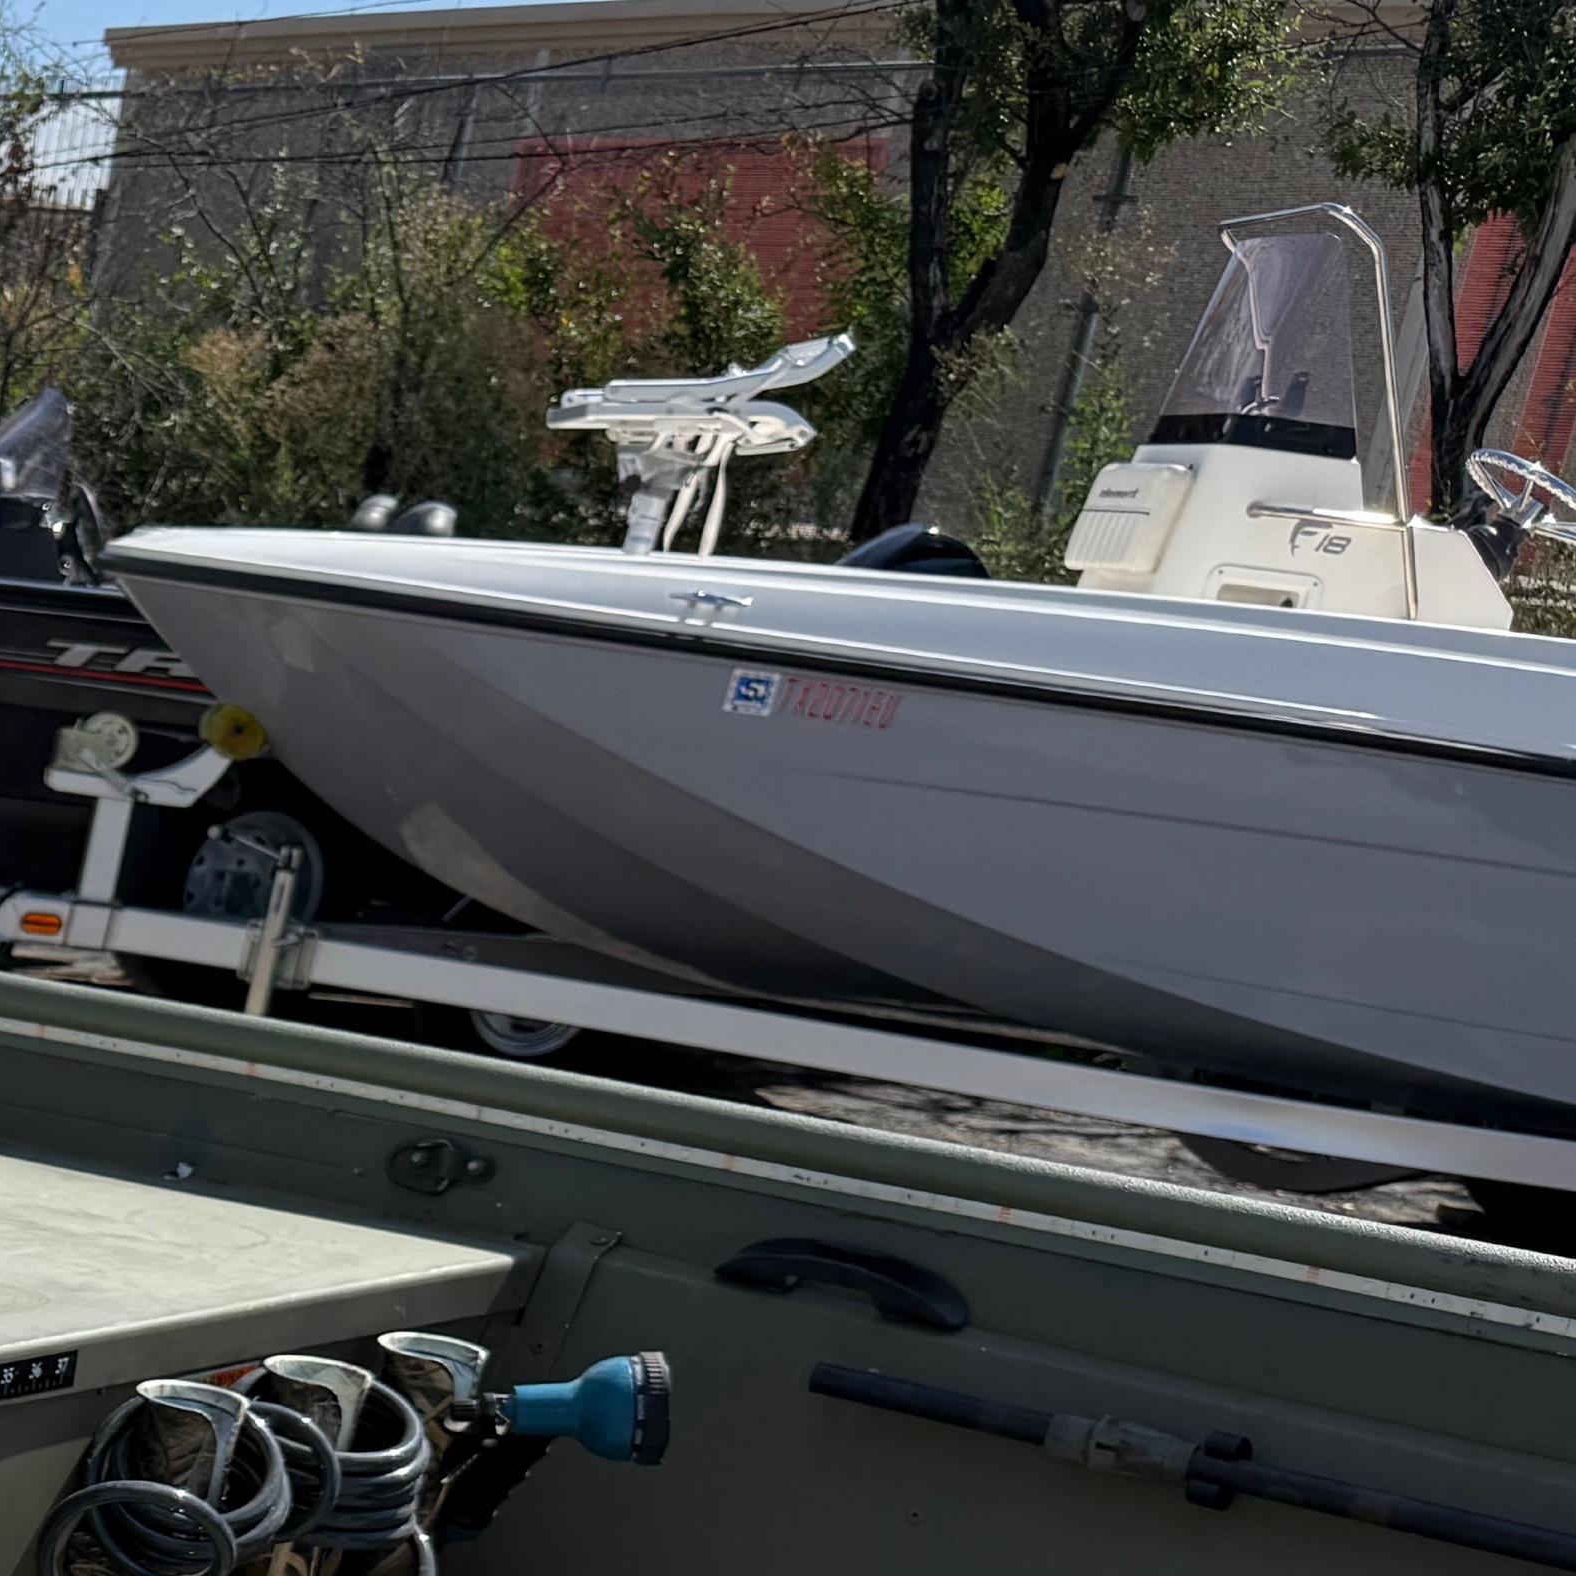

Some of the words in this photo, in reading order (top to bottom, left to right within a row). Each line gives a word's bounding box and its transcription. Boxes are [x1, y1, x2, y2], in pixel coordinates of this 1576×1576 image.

[1289, 519, 1352, 557] F18
[1, 1367, 15, 1384] 35
[29, 1362, 43, 1379] 36
[55, 1357, 69, 1374] 37
